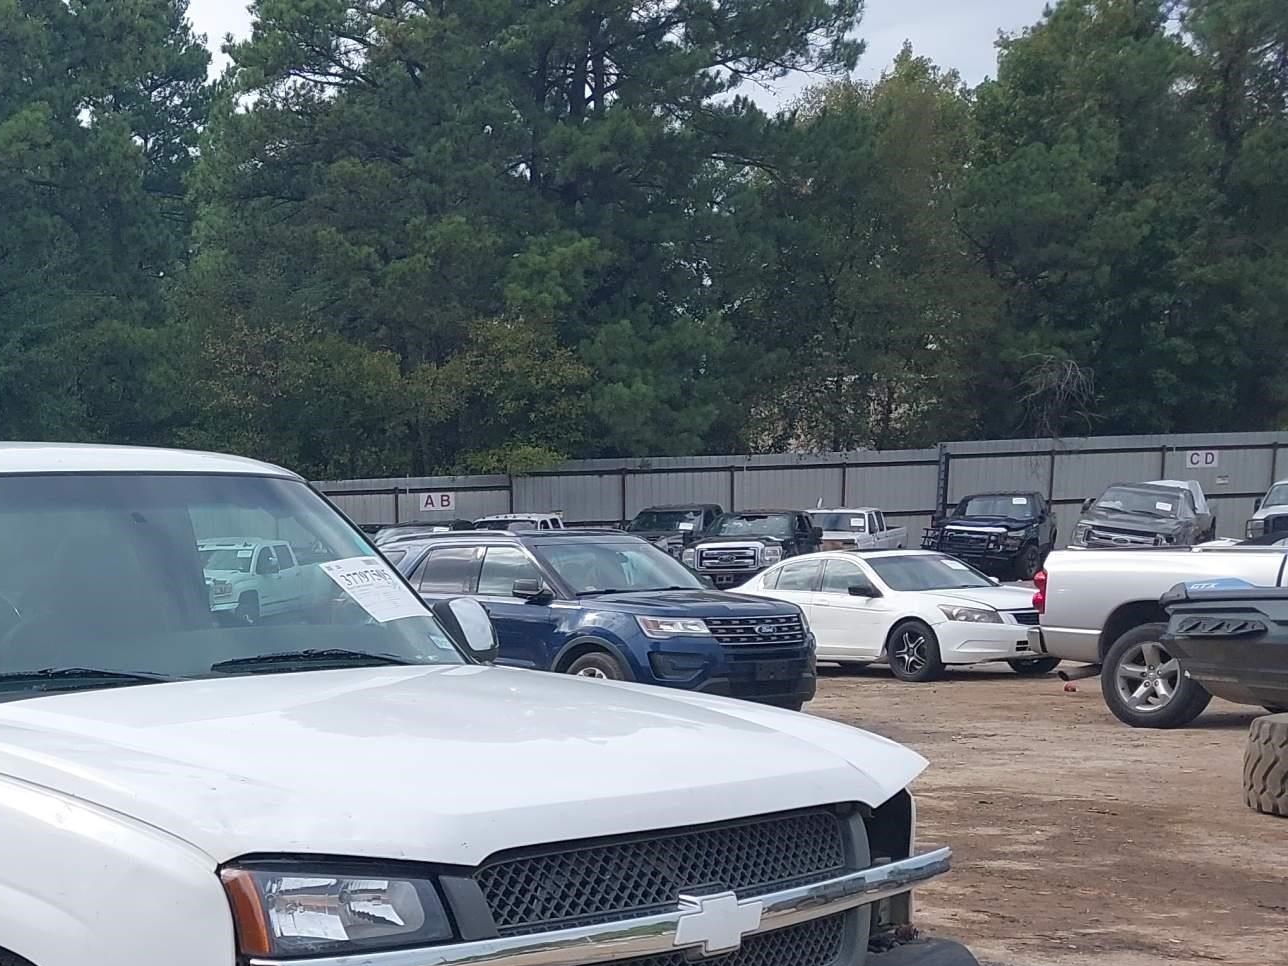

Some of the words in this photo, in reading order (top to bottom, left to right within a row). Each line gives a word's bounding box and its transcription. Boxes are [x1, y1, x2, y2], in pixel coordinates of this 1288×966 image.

[1190, 452, 1200, 465] C
[1204, 452, 1215, 465] D
[423, 494, 435, 507] A
[440, 494, 451, 507] B
